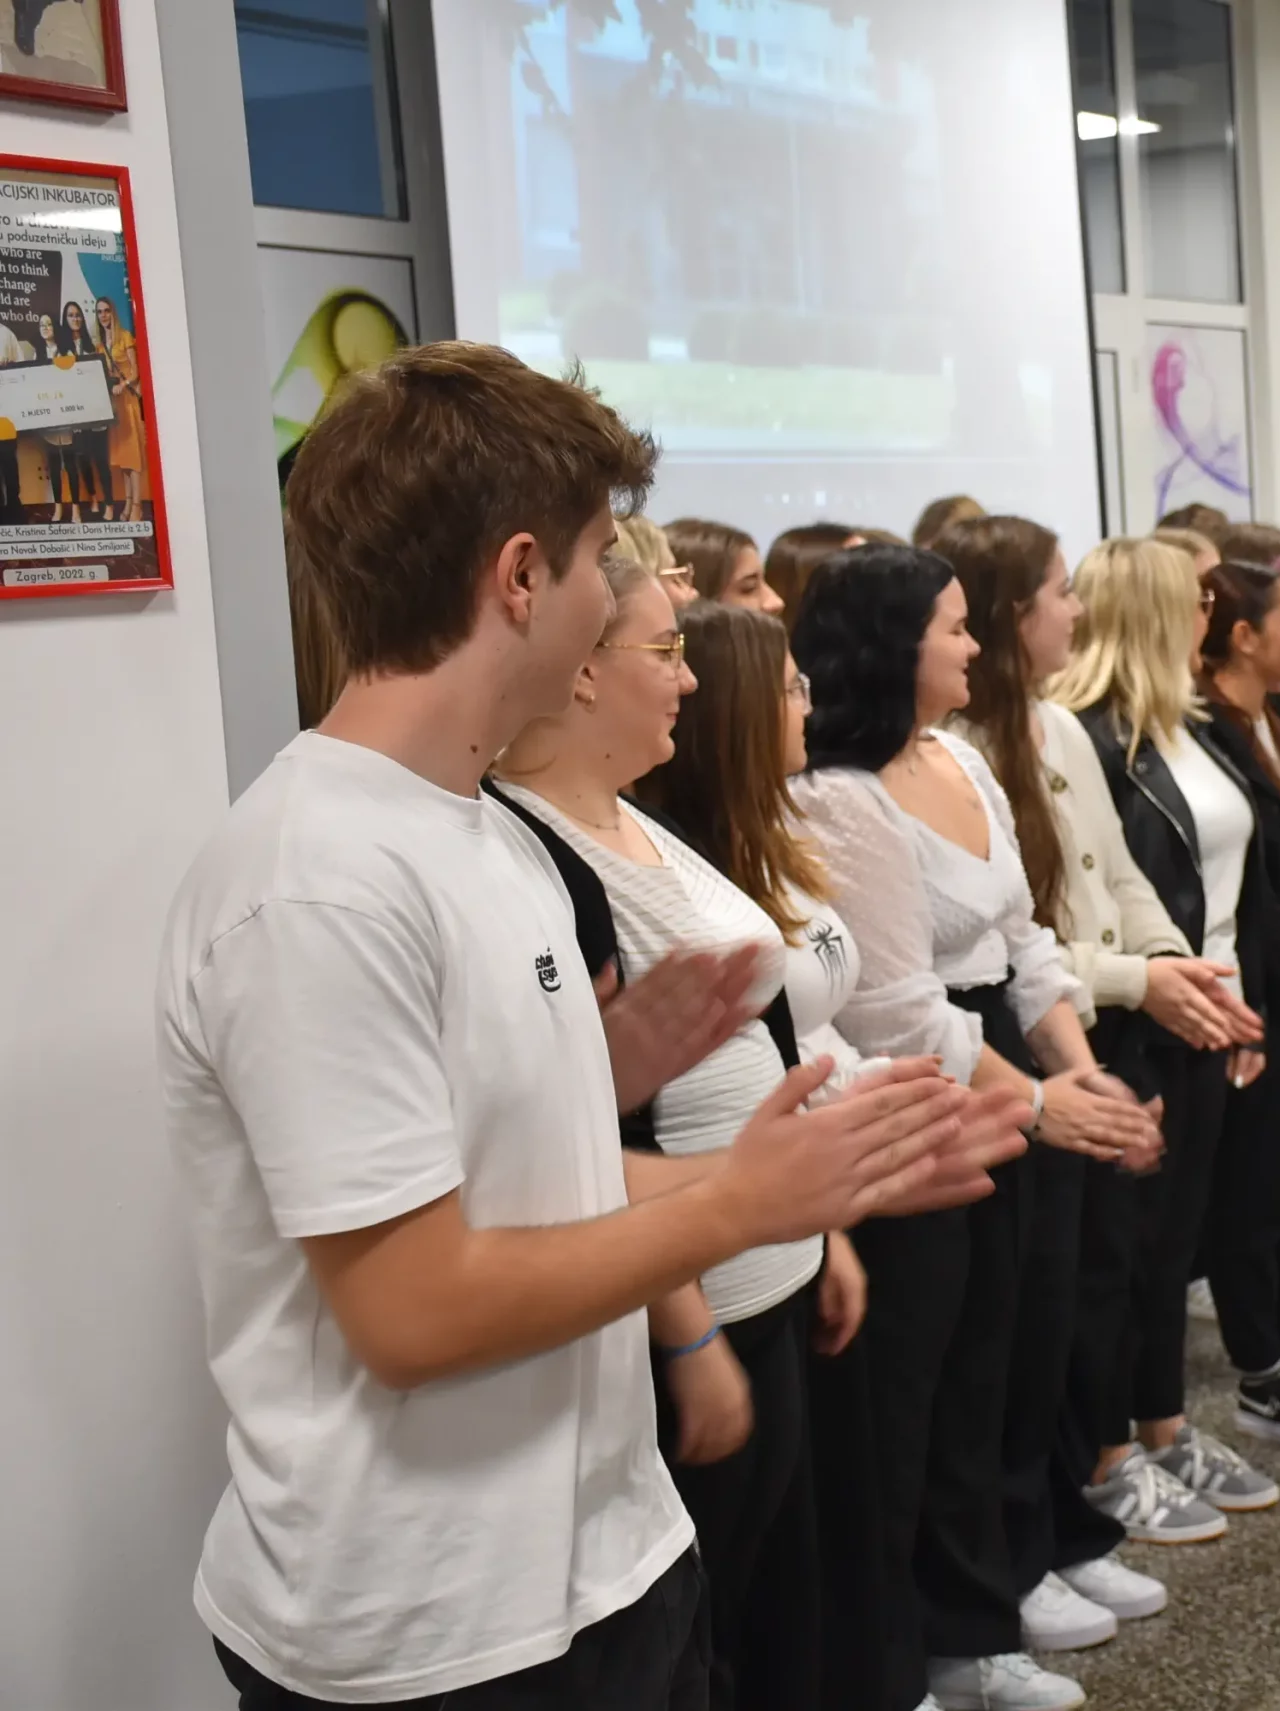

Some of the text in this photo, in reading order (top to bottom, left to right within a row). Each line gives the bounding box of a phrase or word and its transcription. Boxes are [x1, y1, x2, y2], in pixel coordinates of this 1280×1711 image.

[42, 187, 116, 207] INKUBATOR
[7, 228, 78, 246] poduzetničku
[81, 233, 107, 250] ideju
[0, 247, 43, 260] who are
[8, 263, 20, 274] to
[21, 262, 50, 277] think
[0, 276, 37, 294] change
[13, 296, 31, 307] are
[0, 309, 24, 321] who
[15, 526, 46, 537] Kristina
[11, 544, 38, 555] Novak
[76, 542, 96, 552] Nina
[15, 569, 57, 584] Zagreb,
